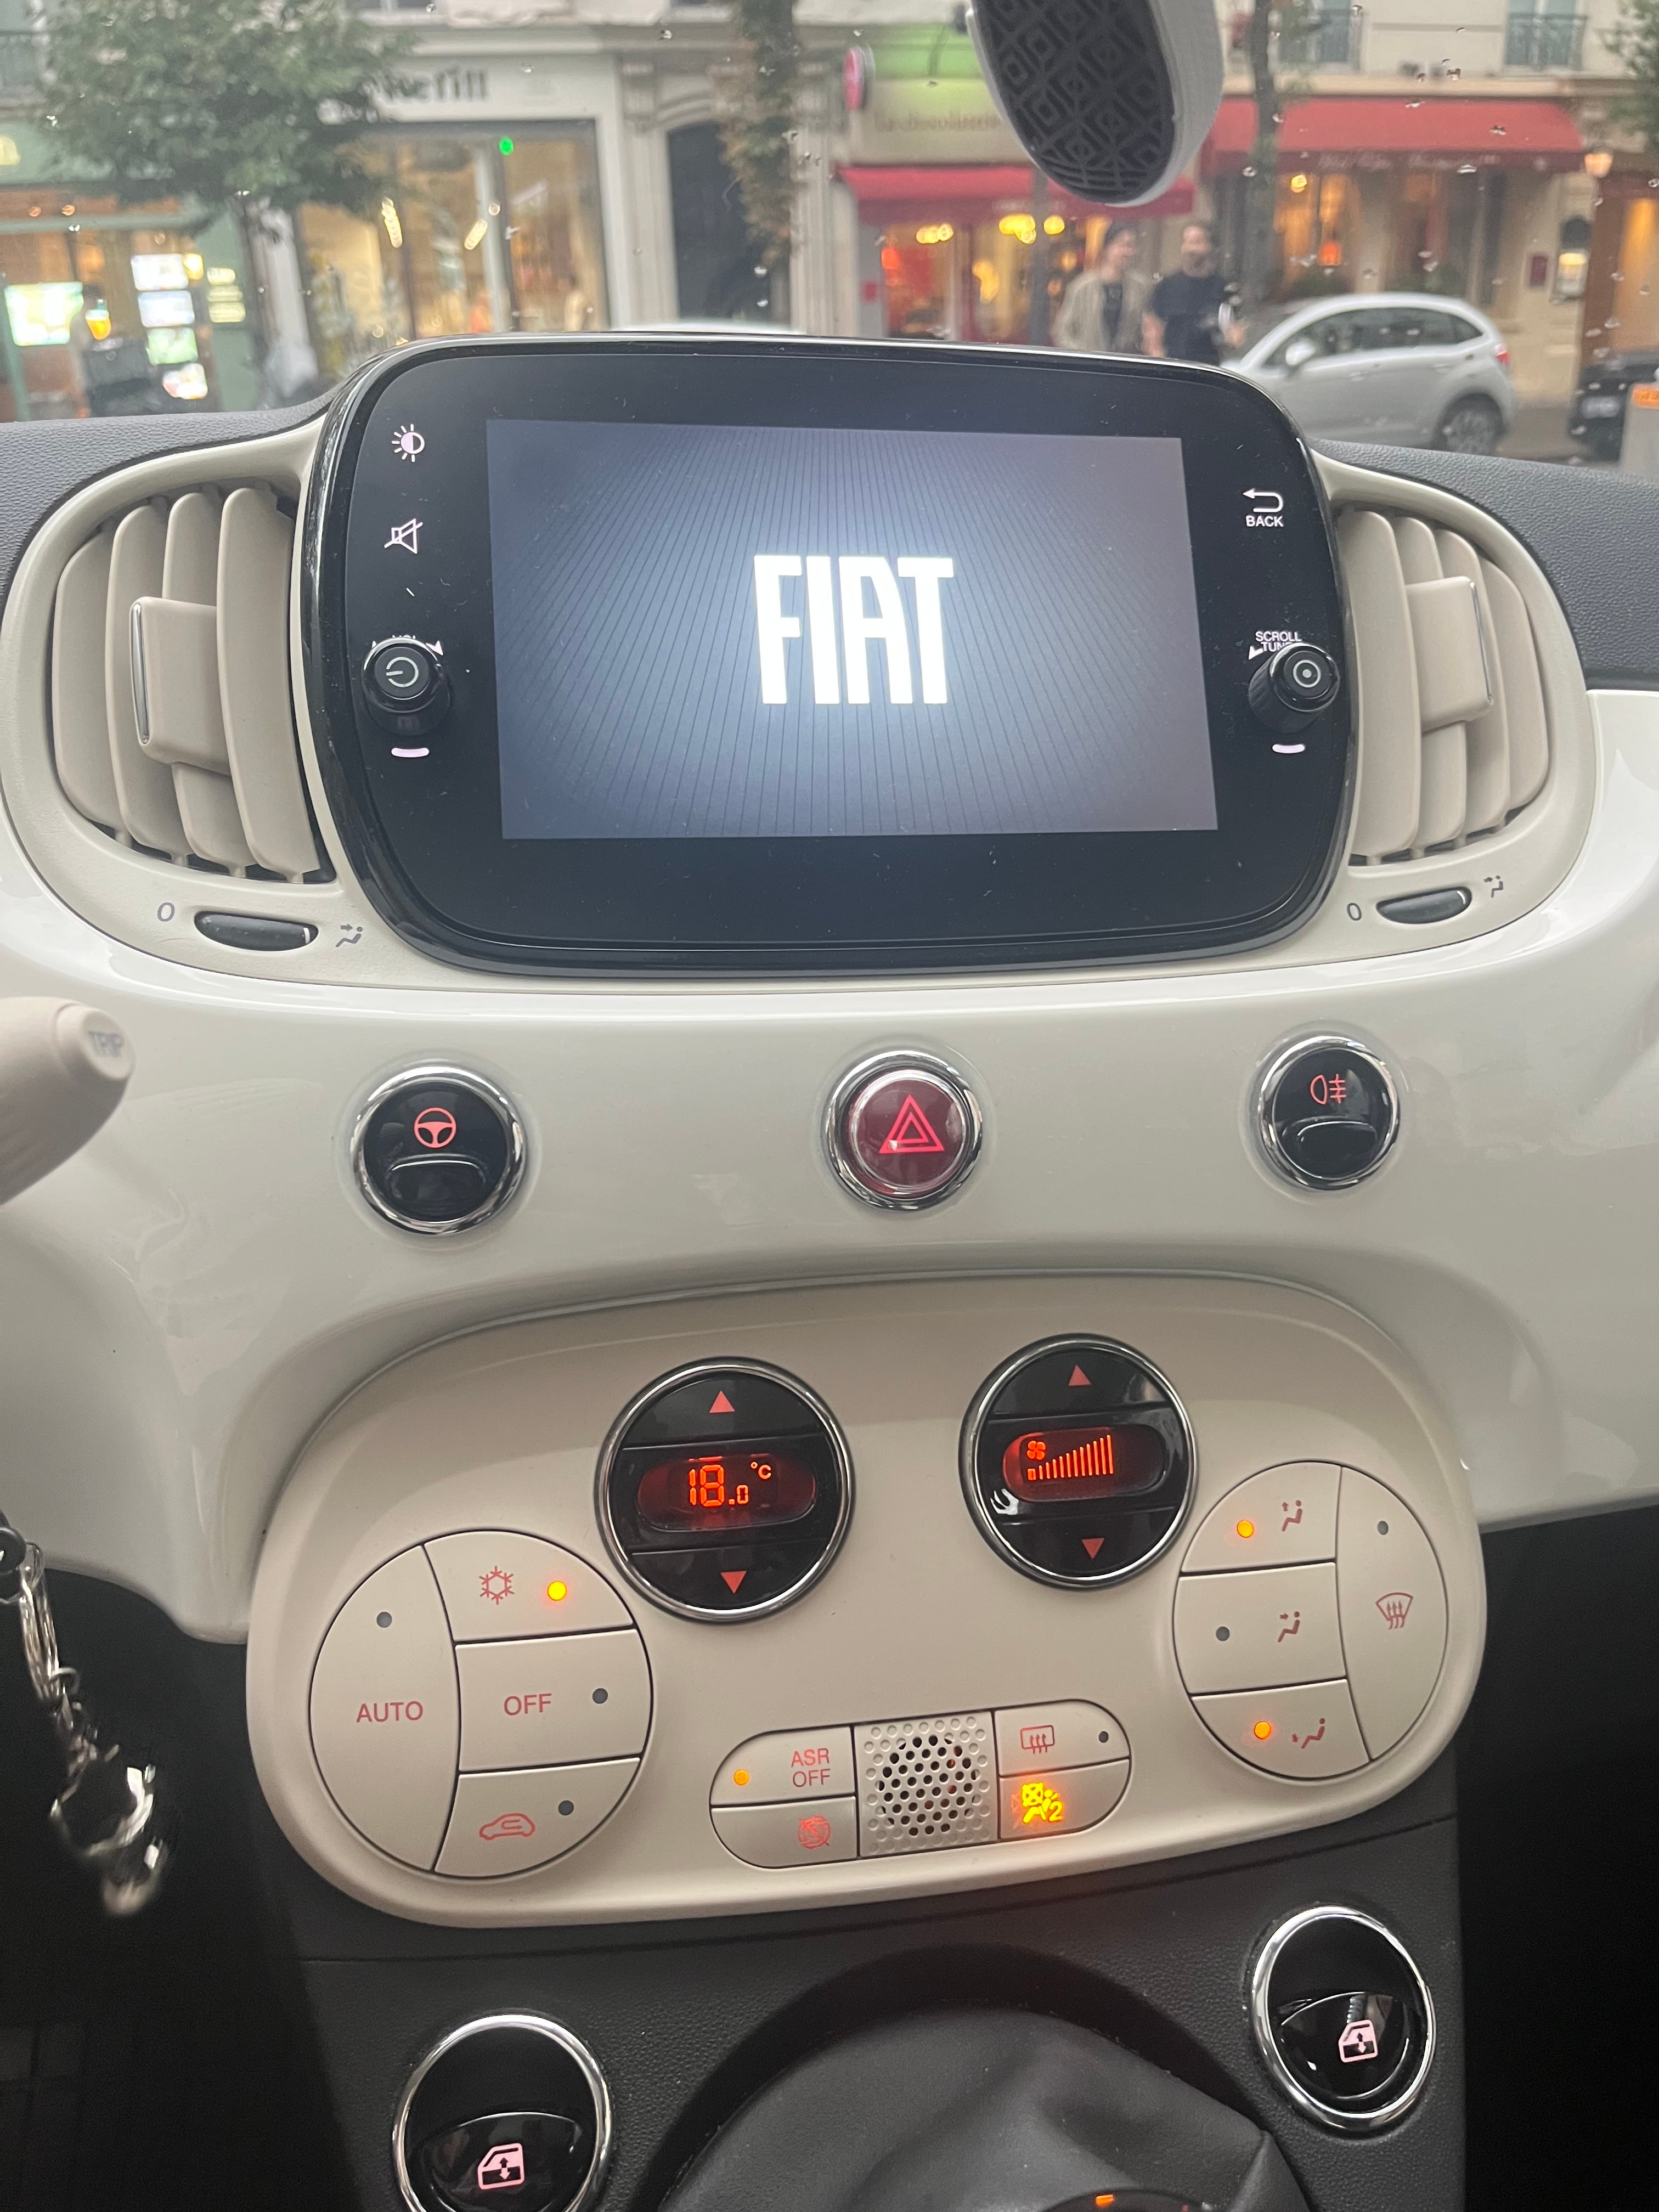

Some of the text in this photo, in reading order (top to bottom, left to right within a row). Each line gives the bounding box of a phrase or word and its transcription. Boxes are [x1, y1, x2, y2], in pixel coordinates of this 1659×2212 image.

[1245, 515, 1284, 527] BACK
[754, 555, 954, 704] FIAT
[1255, 630, 1302, 642] SCROLL
[1261, 641, 1293, 652] TUN
[689, 1464, 749, 1508] 18.0
[356, 1701, 424, 1723] AUTO
[503, 1693, 552, 1716] OFF
[791, 1747, 830, 1768] ASR
[792, 1768, 831, 1788] OFF
